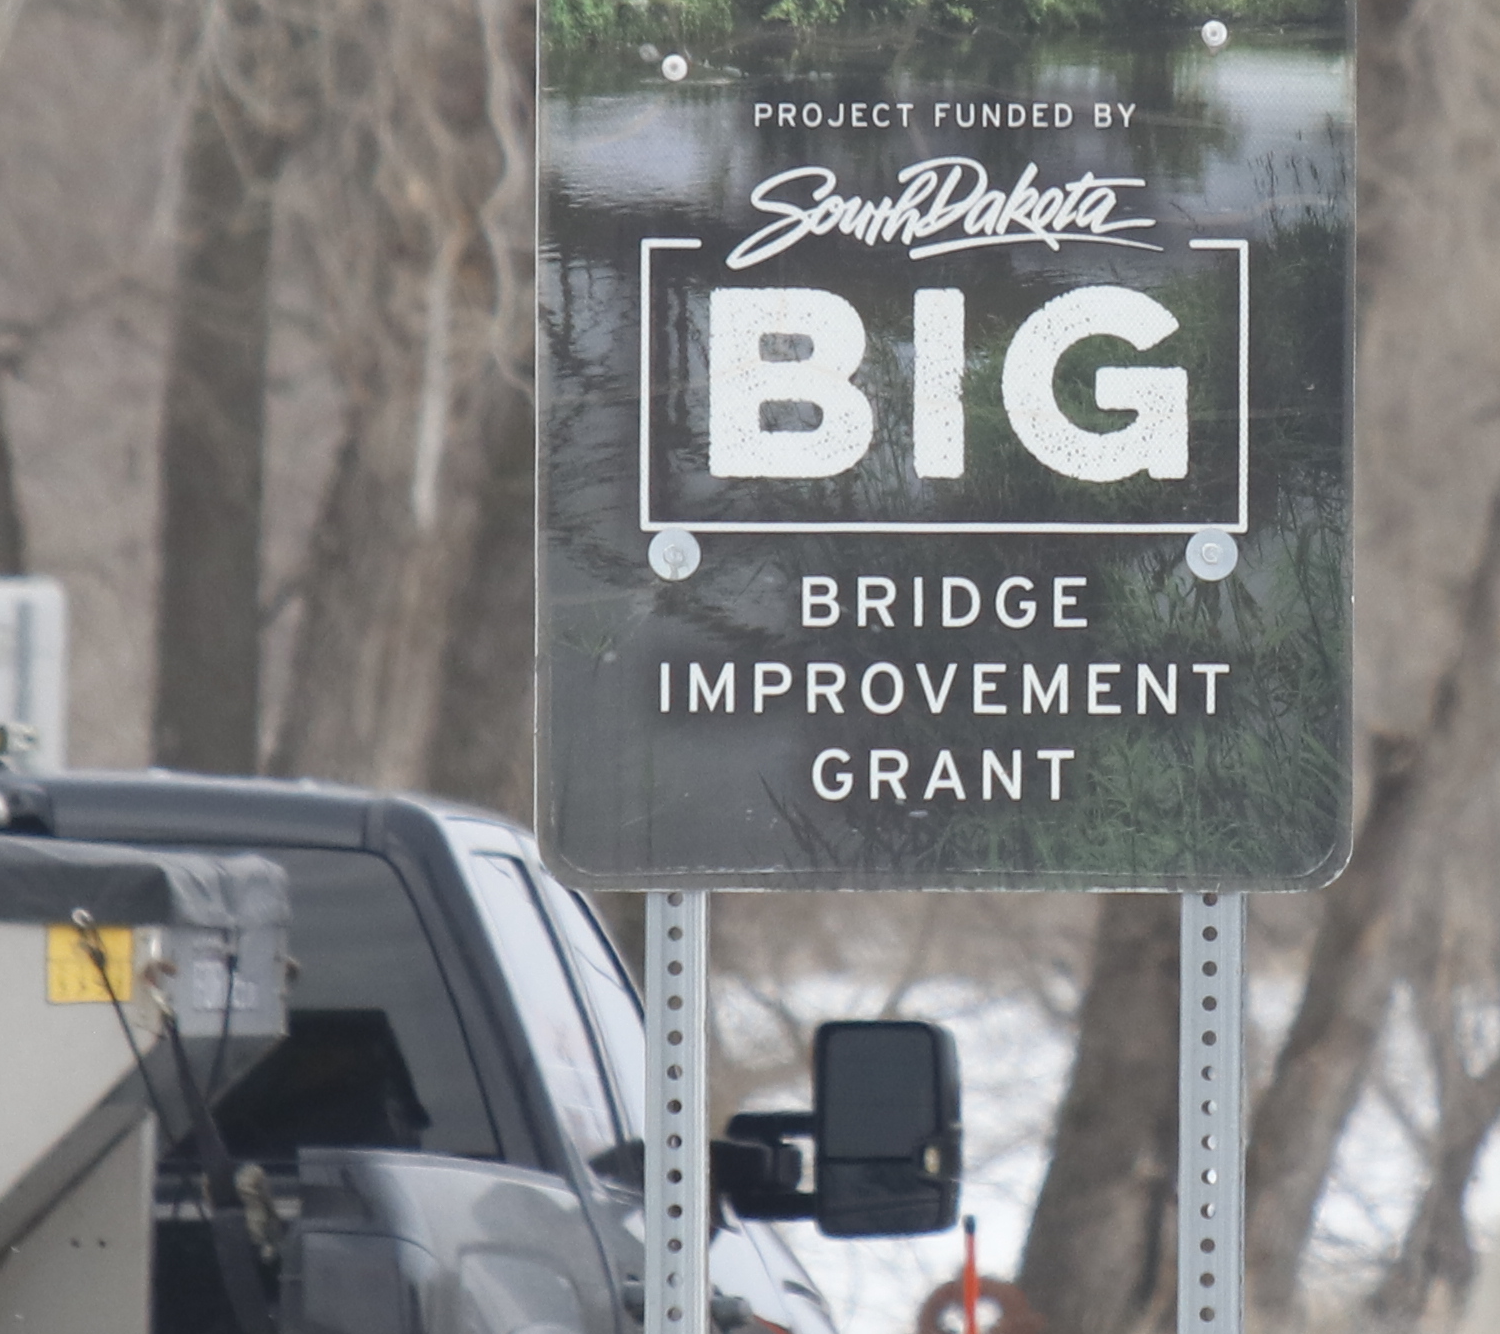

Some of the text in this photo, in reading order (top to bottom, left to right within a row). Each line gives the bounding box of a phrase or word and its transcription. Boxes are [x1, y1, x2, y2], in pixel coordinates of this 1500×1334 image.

[752, 101, 1138, 130] PROJECT FUNDED BY
[708, 284, 1190, 483] BIG
[799, 575, 1090, 629] BRIDGE
[657, 661, 1231, 716] IMPROVEMENT
[810, 747, 1077, 802] GRANT
